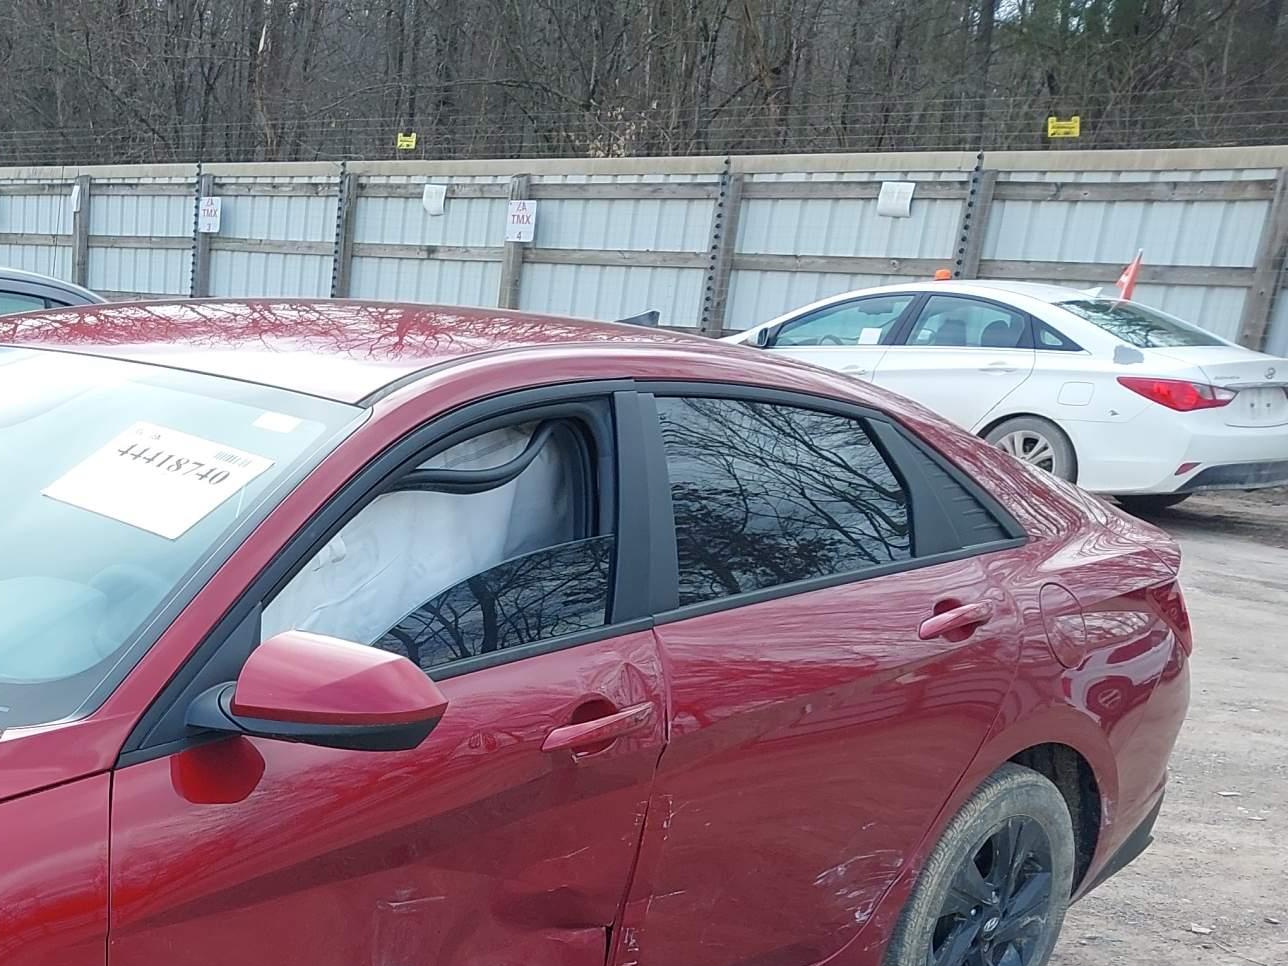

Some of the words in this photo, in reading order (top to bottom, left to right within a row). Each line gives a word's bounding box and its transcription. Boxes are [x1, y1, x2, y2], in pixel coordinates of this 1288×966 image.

[202, 208, 218, 217] TMX
[512, 214, 532, 225] TMX
[117, 443, 231, 485] 44418740
